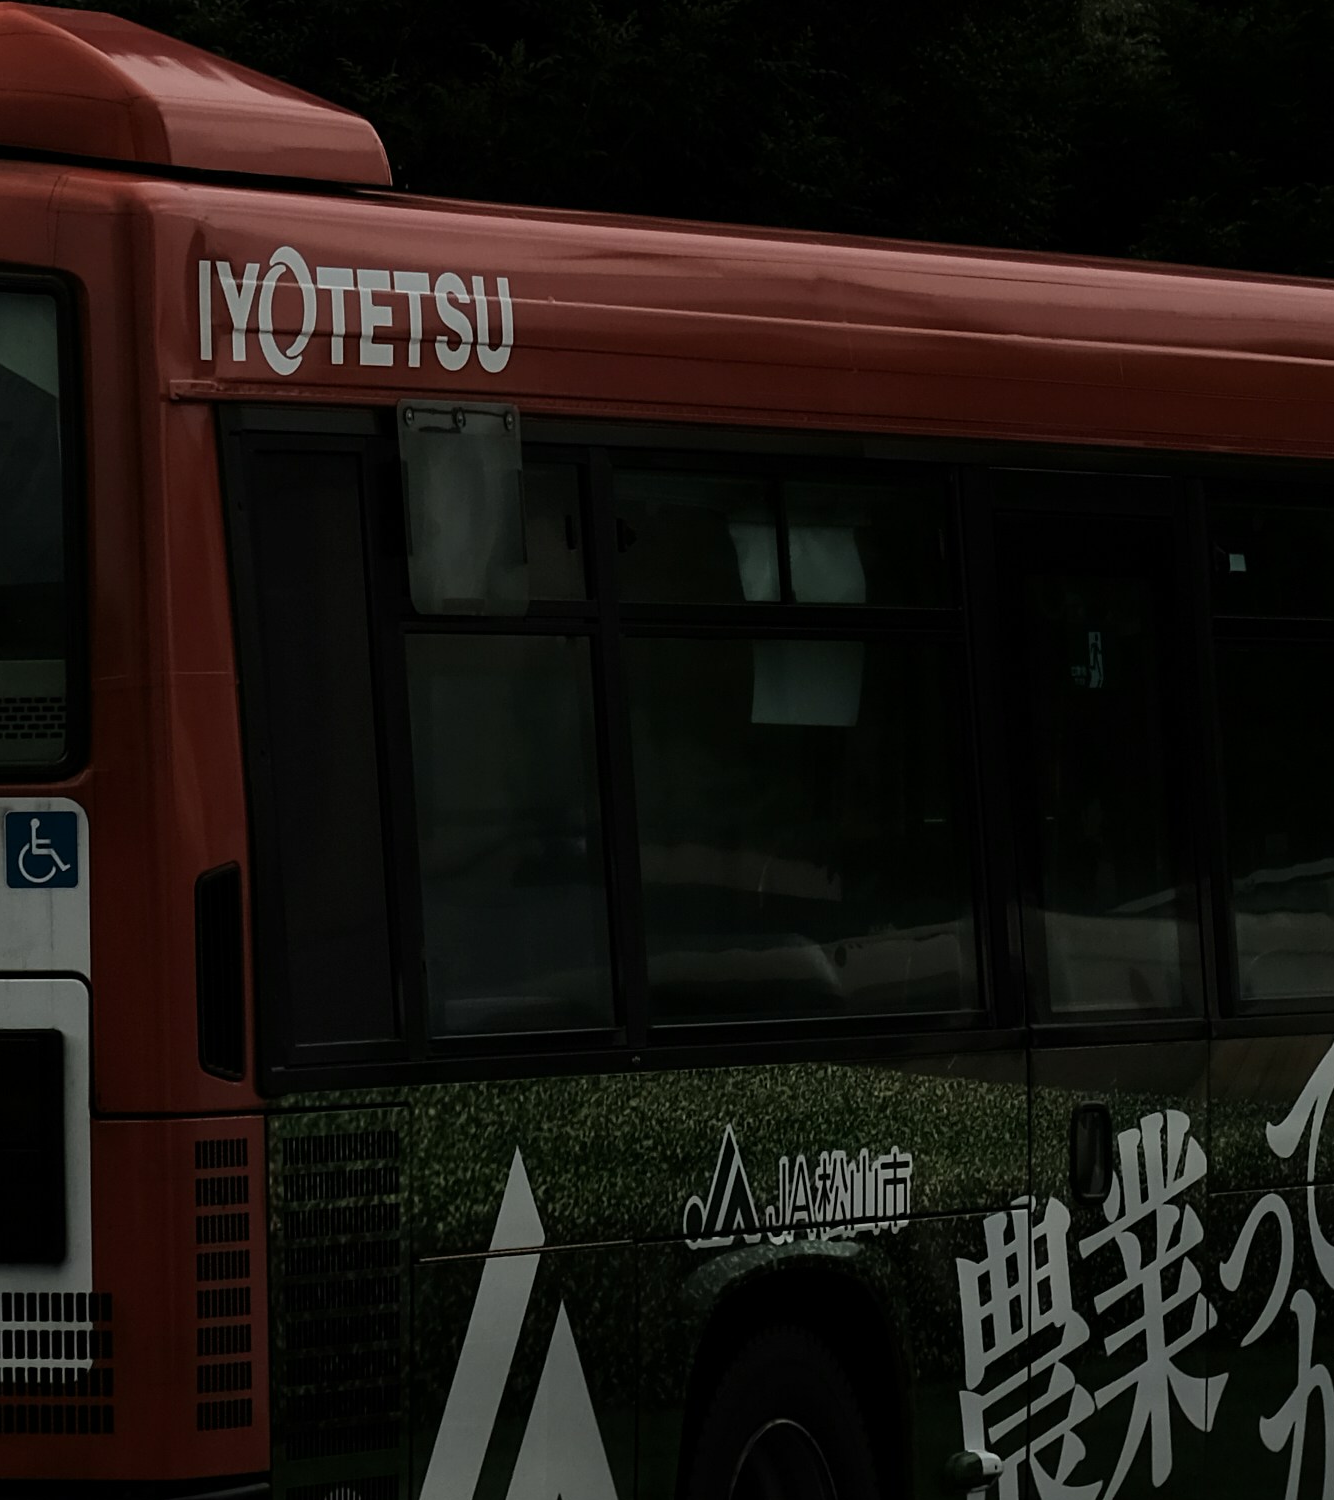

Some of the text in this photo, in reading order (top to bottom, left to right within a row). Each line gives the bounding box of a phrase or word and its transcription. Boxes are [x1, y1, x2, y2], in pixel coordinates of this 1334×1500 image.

[198, 245, 515, 377] IYOTETSU
[766, 1146, 913, 1245] JA松山市
